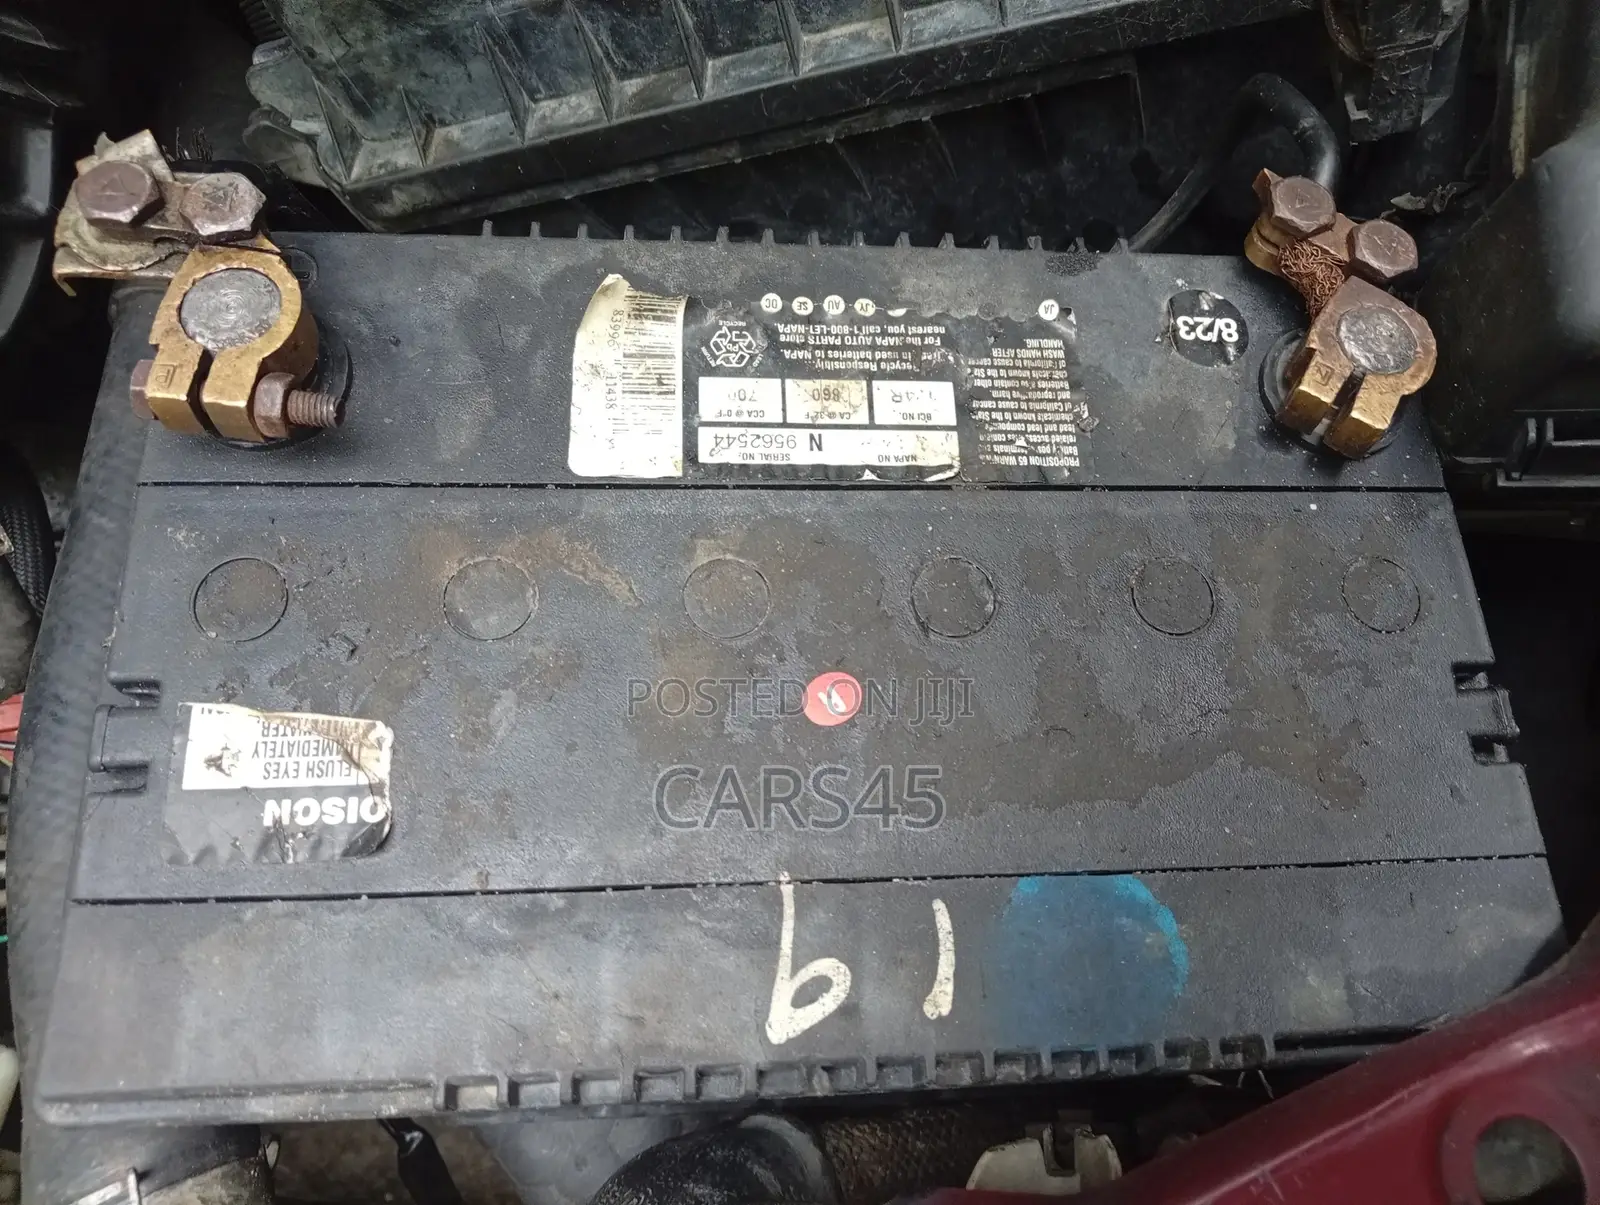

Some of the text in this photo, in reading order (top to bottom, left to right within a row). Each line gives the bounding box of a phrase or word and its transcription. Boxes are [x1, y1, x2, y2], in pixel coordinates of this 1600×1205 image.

[796, 300, 809, 311] SE
[827, 299, 841, 310] AU
[1043, 303, 1055, 315] JA
[862, 325, 881, 335] call
[883, 324, 906, 334] you,
[908, 326, 945, 335] nearest
[1177, 316, 1239, 342] 8/23
[779, 334, 941, 346] For the NAPA AUTO PARTS store
[1023, 338, 1065, 348] HANDLING.
[726, 343, 740, 352] Pb
[992, 347, 1065, 358] WASH HANDS AFTER
[780, 349, 812, 360] NAPA.
[815, 350, 825, 360] to
[827, 350, 872, 361] batteries
[875, 351, 899, 360] used
[993, 356, 1013, 365] cause
[1014, 357, 1022, 367] to
[1059, 358, 1066, 367] of
[986, 367, 998, 377] the
[999, 368, 1006, 377] to
[1007, 368, 1031, 377] known
[973, 378, 992, 388] other
[993, 378, 1020, 388] contain
[1037, 380, 1070, 389] Batteries
[812, 387, 840, 402] 860
[989, 389, 1010, 399] harm.
[1057, 390, 1071, 399] and
[997, 400, 1018, 409] cause
[1020, 401, 1027, 410] to
[746, 409, 765, 418] CCA
[838, 411, 851, 421] CA
[917, 412, 932, 421] BCI
[991, 411, 1003, 421] the
[1004, 412, 1012, 421] to
[1013, 412, 1036, 421] known
[1038, 412, 1073, 422] chemicals
[1027, 423, 1042, 432] lead
[1044, 423, 1057, 432] and
[1059, 423, 1075, 433] lead
[713, 432, 823, 452] N 9562544
[759, 452, 791, 462] SERIAL
[893, 454, 917, 463] NAPA
[1018, 456, 1028, 465] 65
[1029, 456, 1080, 467] PROPOSITION
[263, 761, 300, 780] EYES
